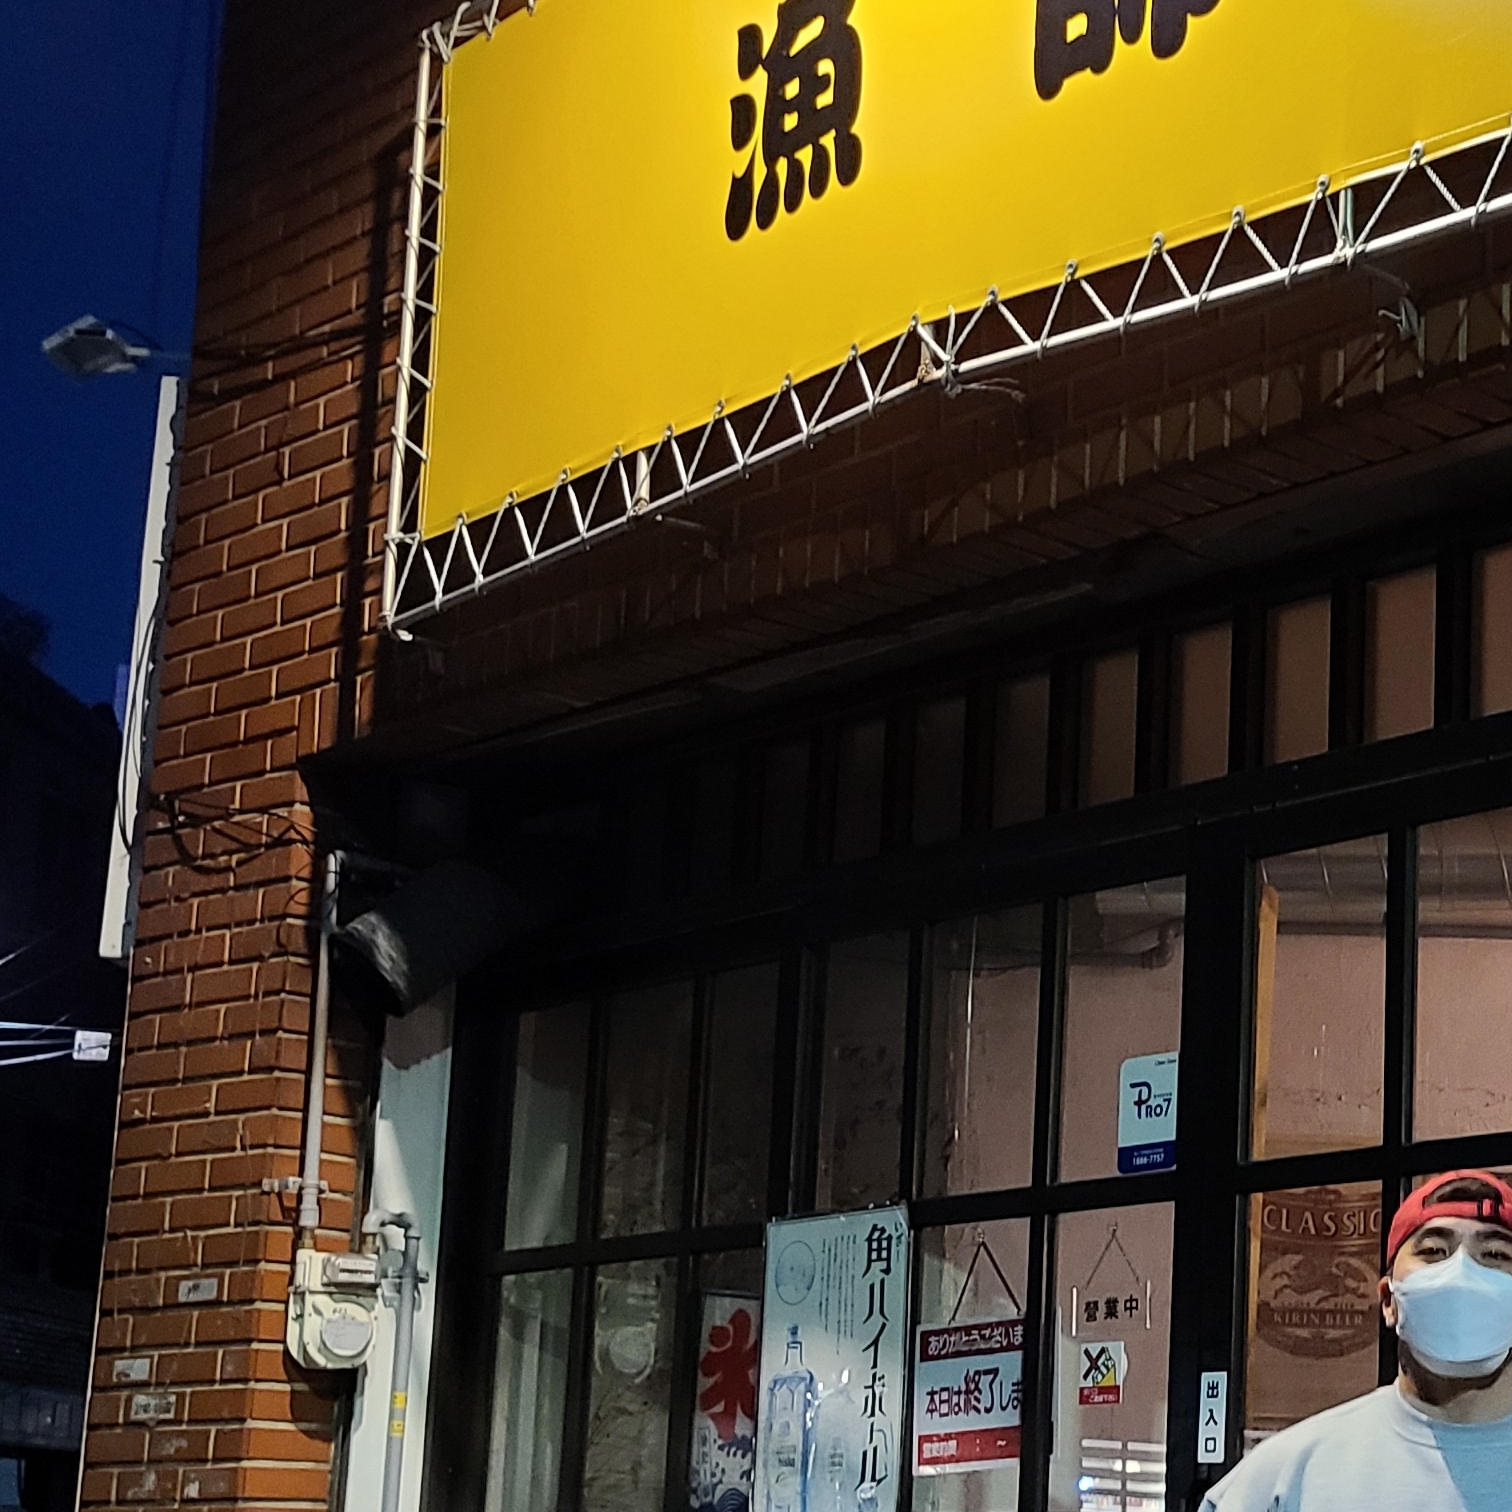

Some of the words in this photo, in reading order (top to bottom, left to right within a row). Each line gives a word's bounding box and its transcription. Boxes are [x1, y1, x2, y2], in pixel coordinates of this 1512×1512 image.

[854, 1223, 894, 1492] 角ハイボール
[926, 1367, 1023, 1420] 本日は終了しま
[1204, 1380, 1219, 1453] 出入口
